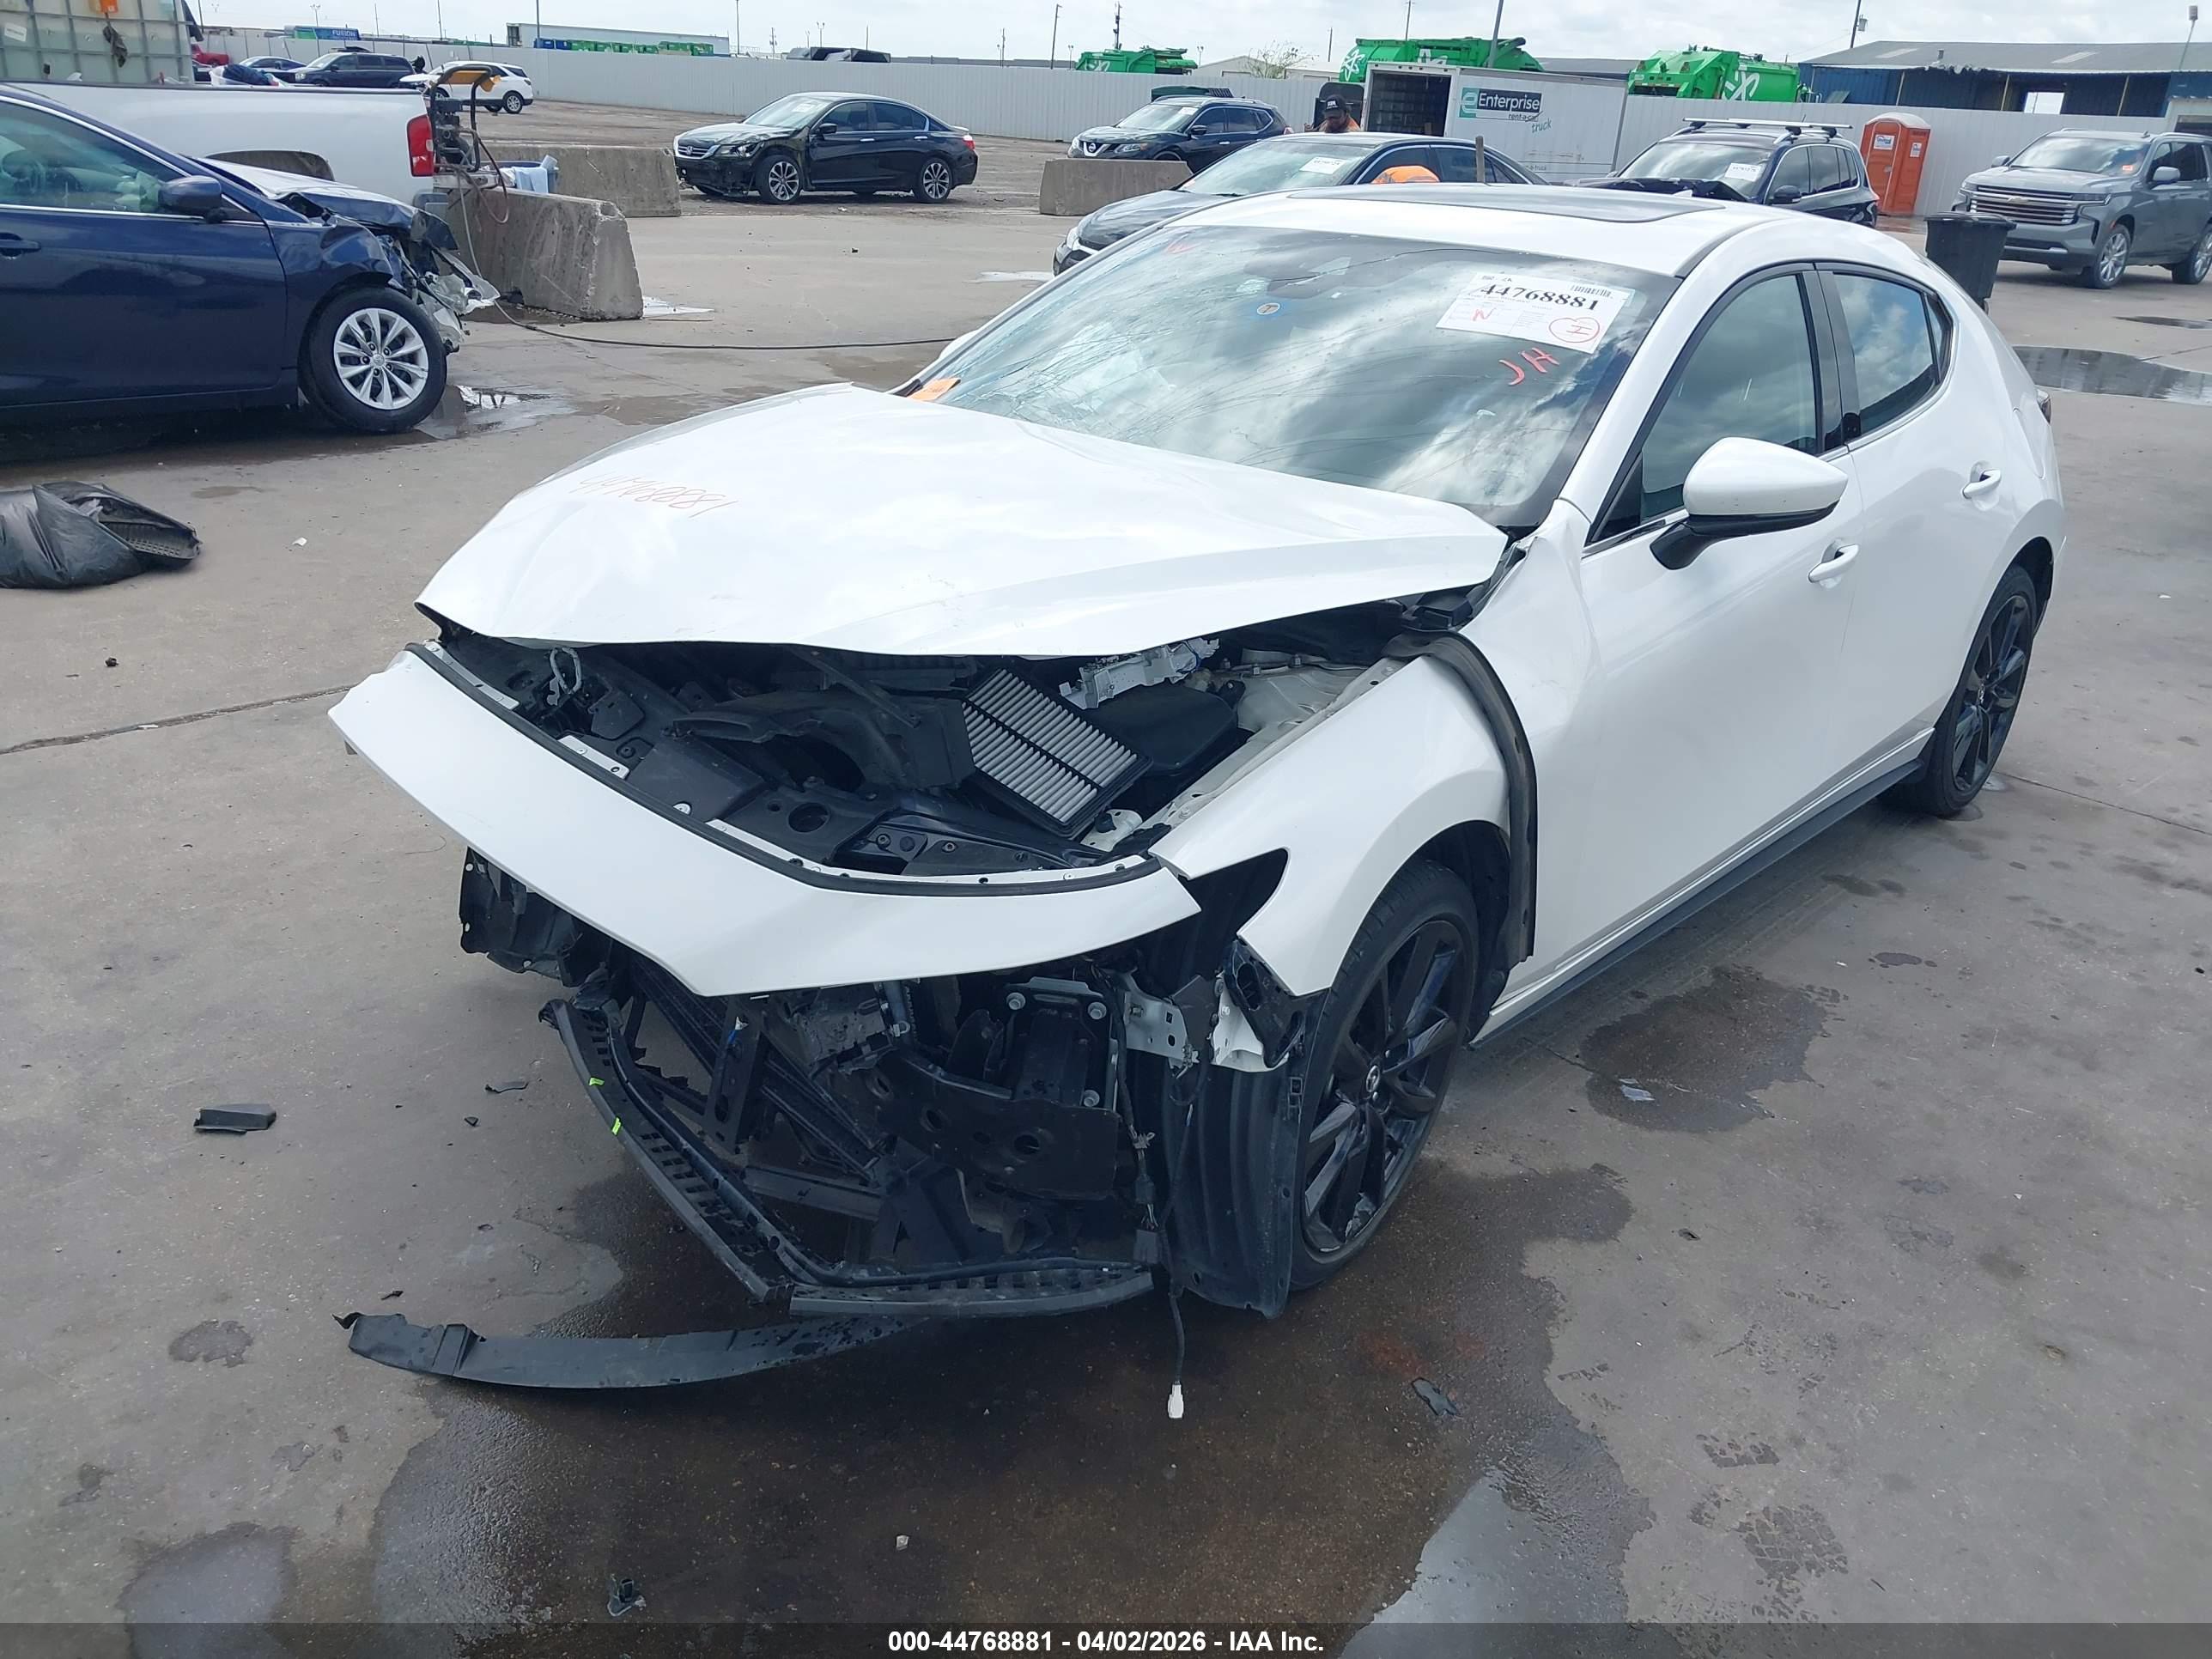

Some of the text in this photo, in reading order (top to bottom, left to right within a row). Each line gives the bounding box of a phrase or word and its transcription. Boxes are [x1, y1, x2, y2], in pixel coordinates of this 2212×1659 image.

[1479, 93, 1540, 112] Enterprise
[1532, 118, 1552, 133] truck
[1480, 284, 1599, 310] 44768881
